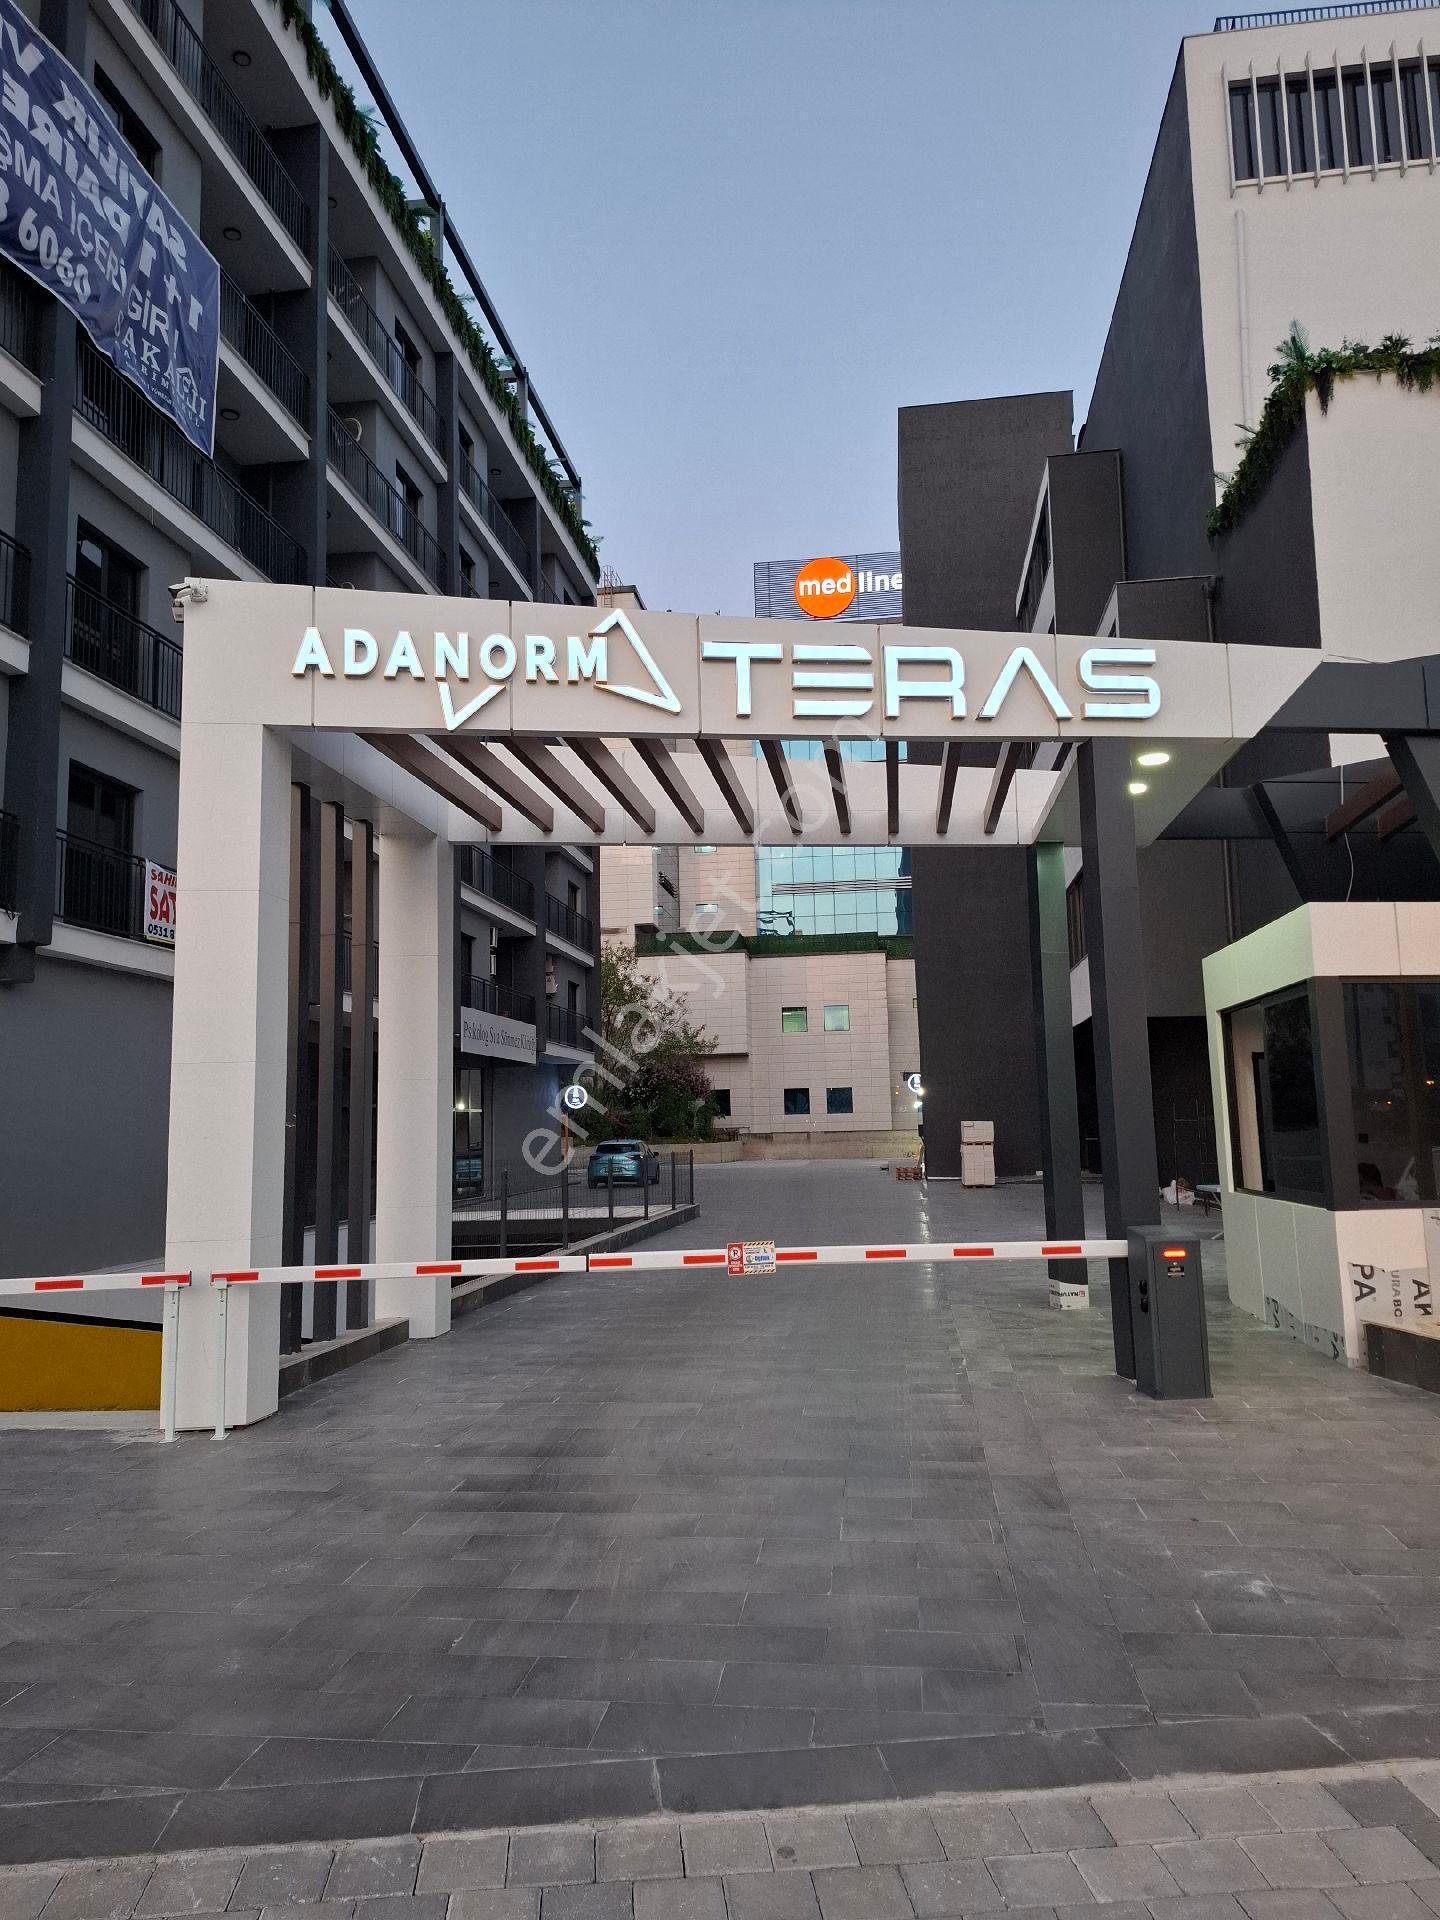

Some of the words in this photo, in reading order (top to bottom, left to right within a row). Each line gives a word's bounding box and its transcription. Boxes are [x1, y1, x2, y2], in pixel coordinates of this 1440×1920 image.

[18, 208, 91, 304] 6060
[70, 192, 127, 297] İÇERİ
[291, 626, 609, 686] ADANORM
[701, 640, 1161, 721] TERAS
[148, 923, 169, 938] 0531
[463, 1020, 489, 1047] Pskolog
